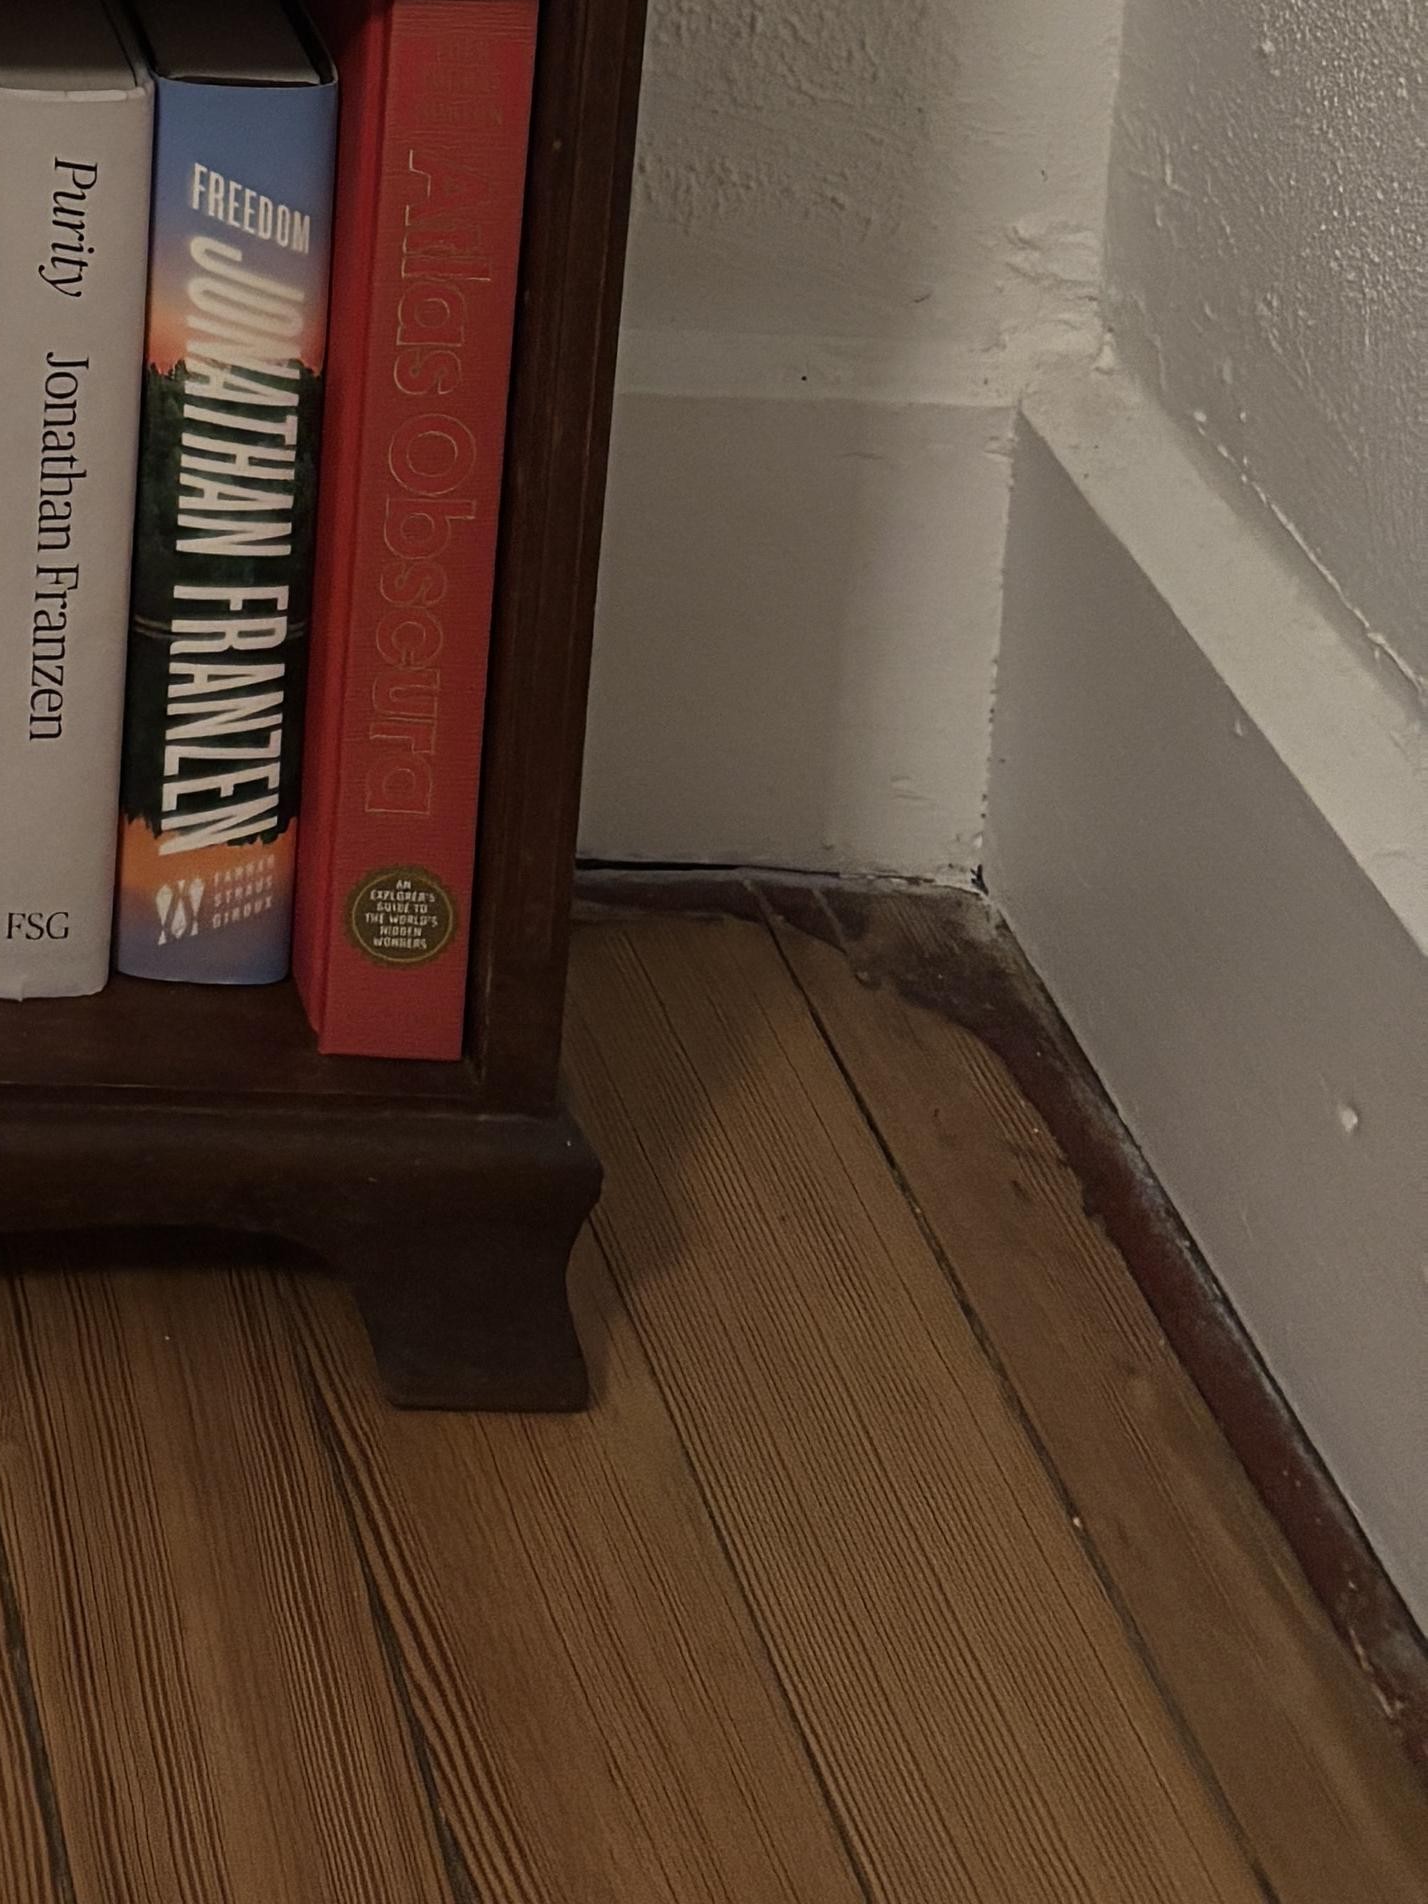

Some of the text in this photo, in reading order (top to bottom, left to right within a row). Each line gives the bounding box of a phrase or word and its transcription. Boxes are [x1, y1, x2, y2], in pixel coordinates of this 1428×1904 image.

[192, 163, 311, 255] FREEDOM
[28, 157, 98, 741] Purity Jonathan Franzen
[6, 911, 71, 941] FSG
